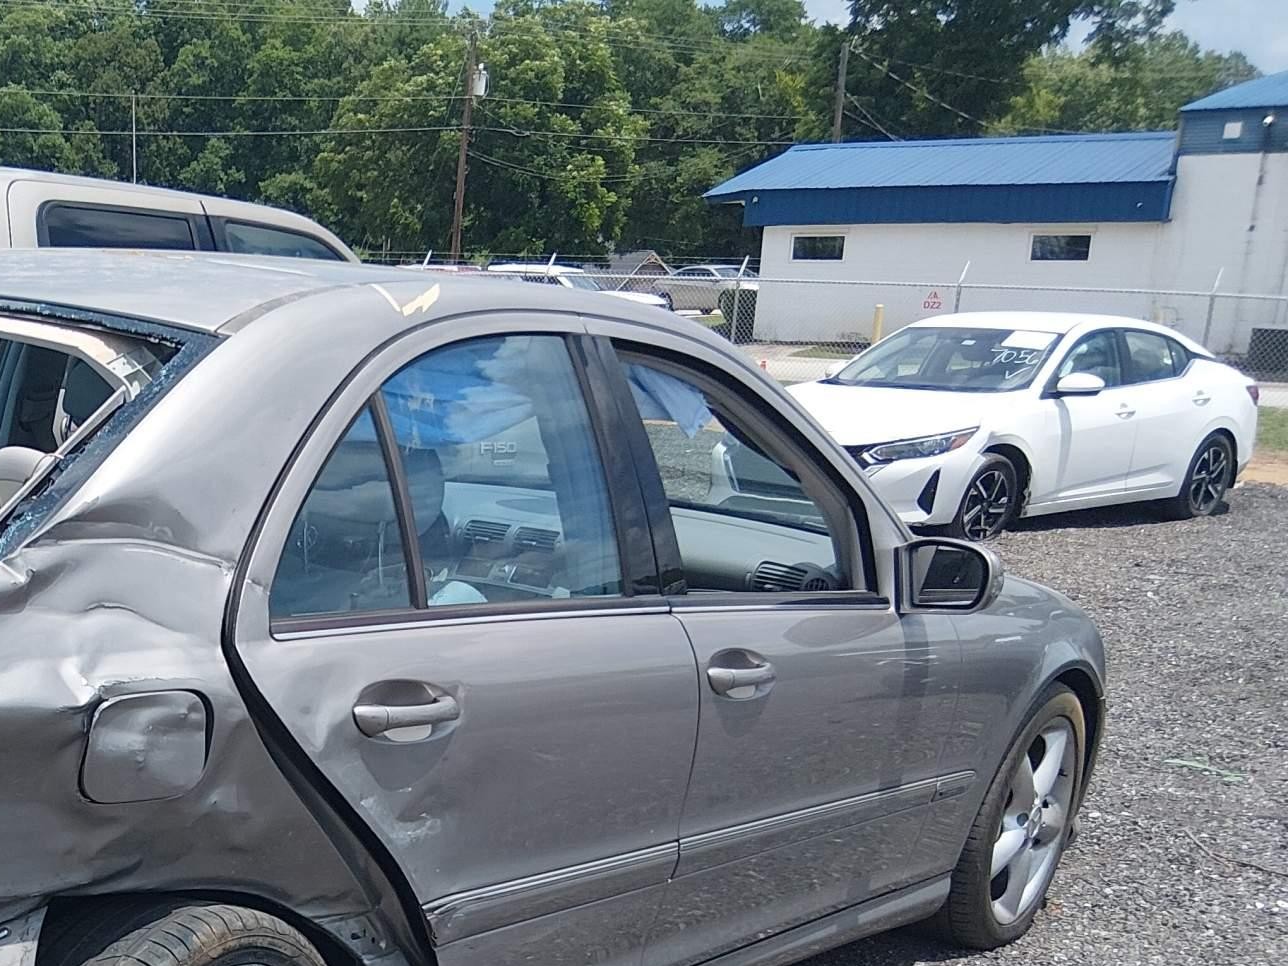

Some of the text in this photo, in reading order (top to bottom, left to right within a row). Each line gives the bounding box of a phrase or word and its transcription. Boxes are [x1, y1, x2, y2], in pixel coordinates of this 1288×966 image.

[923, 300, 942, 310] DZ2
[990, 348, 1041, 366] 7056
[480, 441, 517, 455] F150
